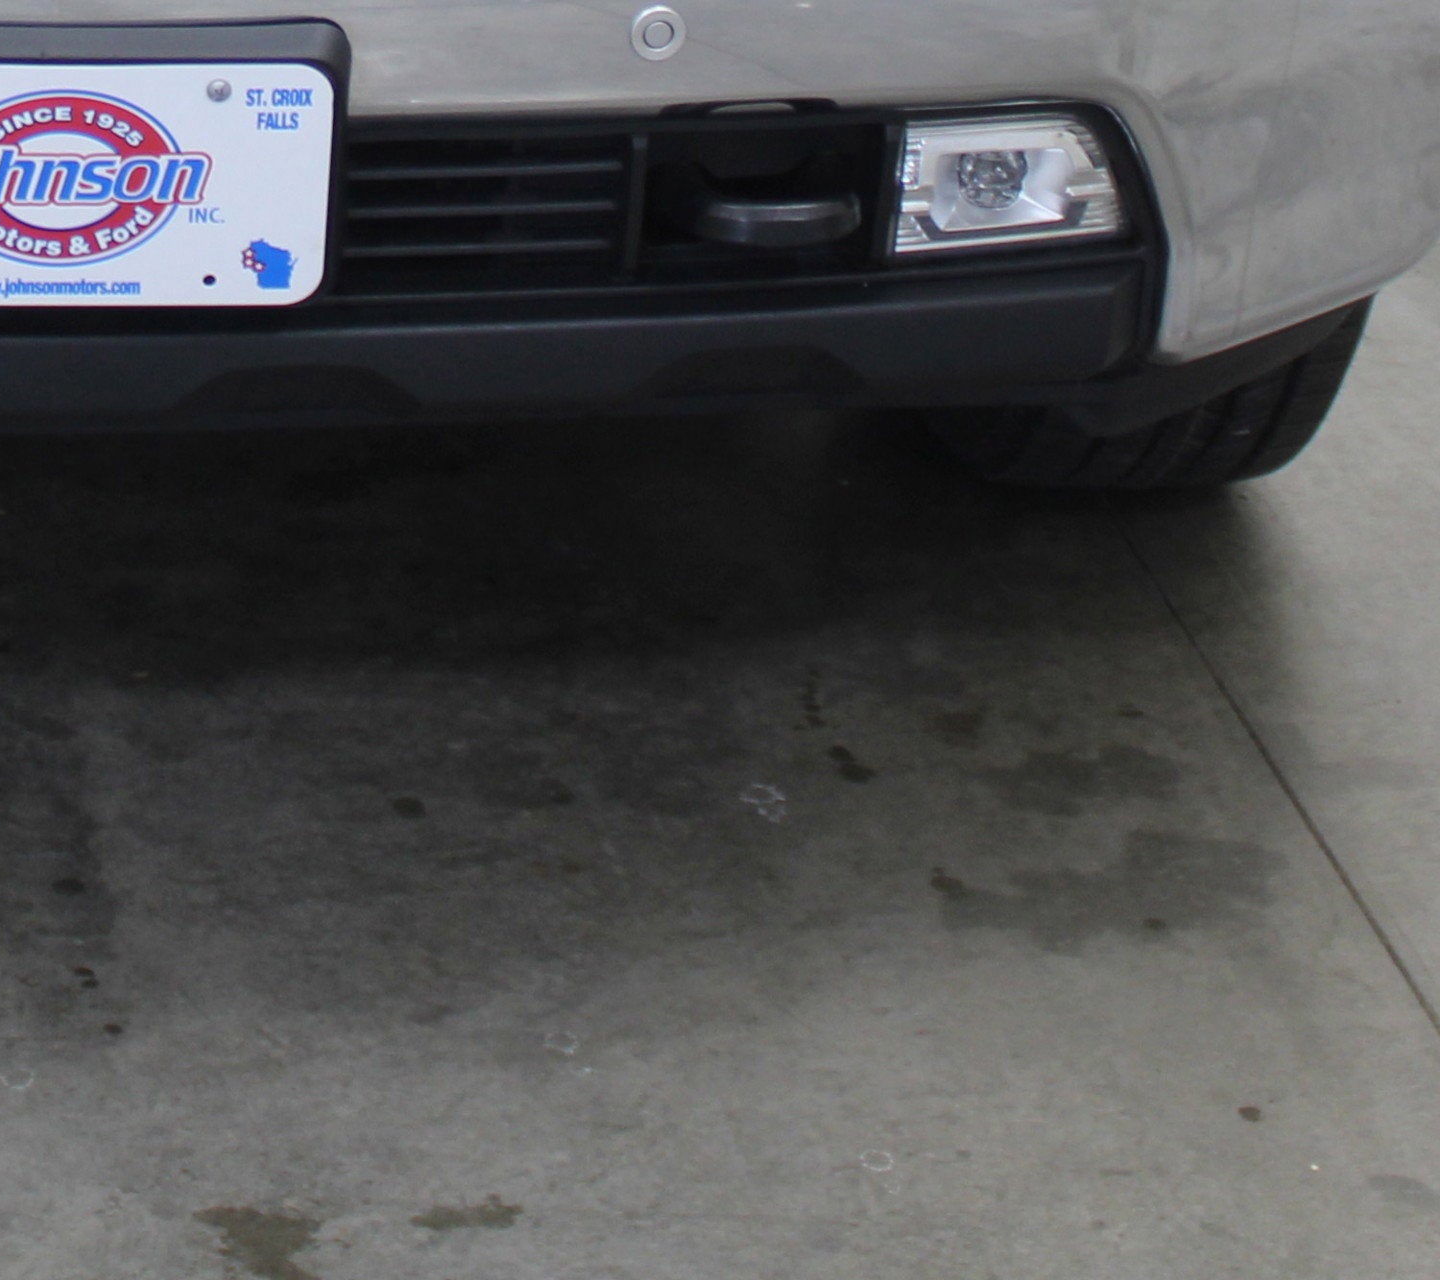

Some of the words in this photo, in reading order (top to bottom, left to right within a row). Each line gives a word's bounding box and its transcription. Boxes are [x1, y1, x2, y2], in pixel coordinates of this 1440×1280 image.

[245, 89, 267, 107] ST.
[271, 89, 312, 107] CROIX
[83, 109, 145, 148] 1925
[257, 113, 299, 130] FALLS
[188, 207, 226, 224] INC.
[68, 235, 92, 255] &
[94, 206, 155, 251] Ford
